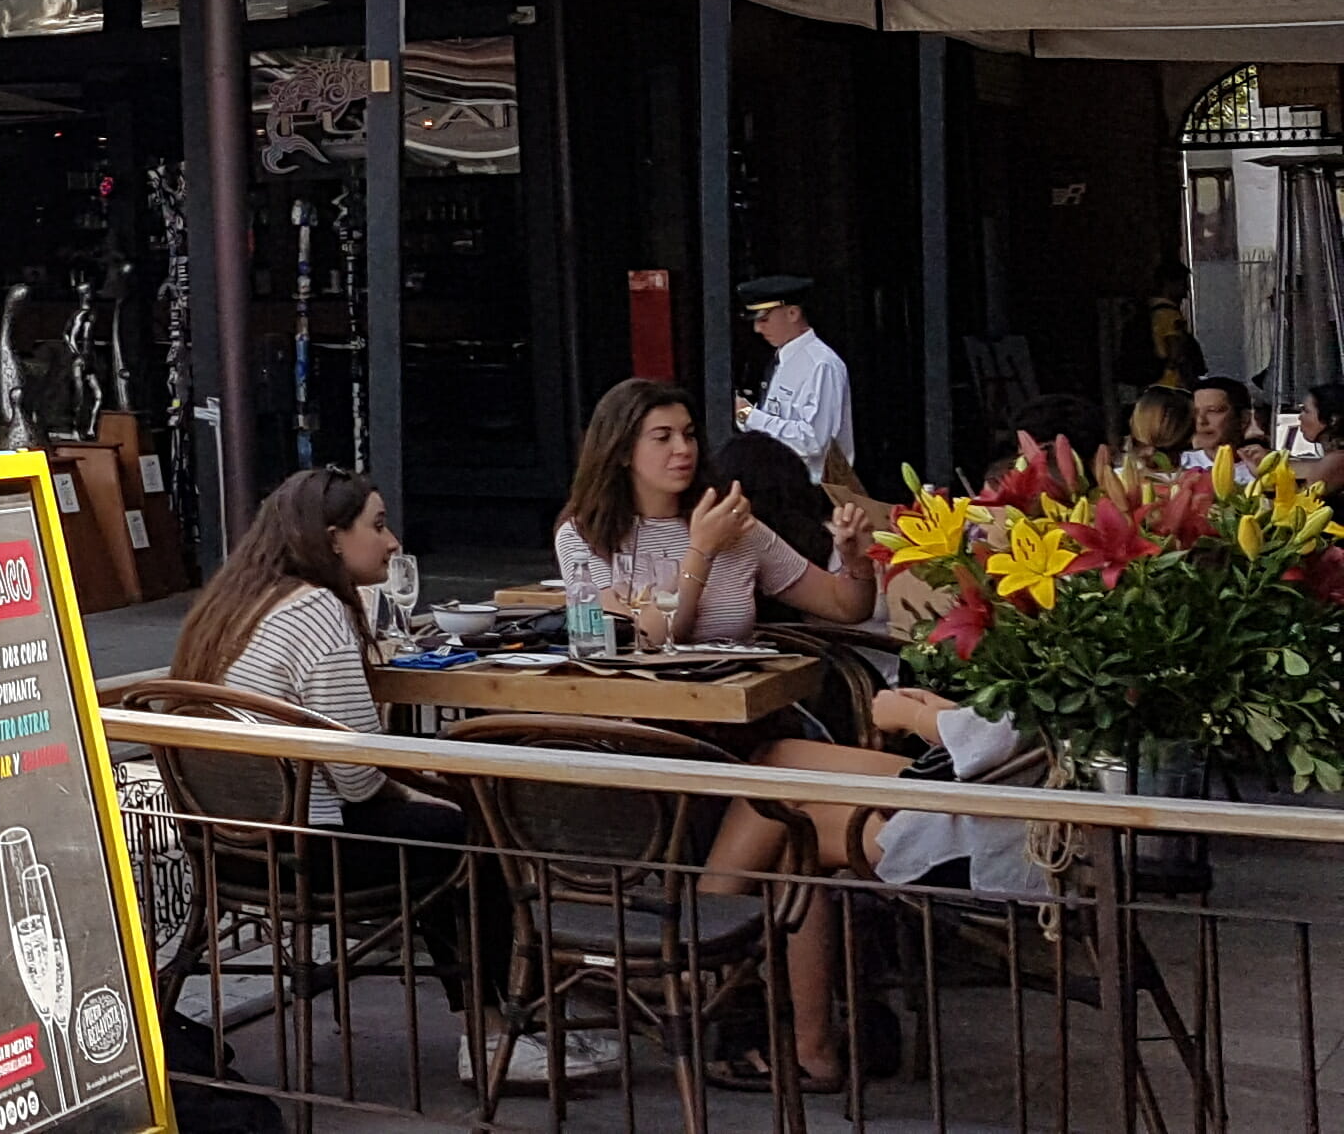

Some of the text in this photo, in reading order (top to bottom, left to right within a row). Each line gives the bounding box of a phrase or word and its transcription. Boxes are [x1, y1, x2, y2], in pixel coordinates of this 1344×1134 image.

[2, 645, 20, 669] DOS
[20, 640, 48, 665] COPAS
[17, 710, 50, 737] OSTRAS
[12, 752, 20, 775] Y
